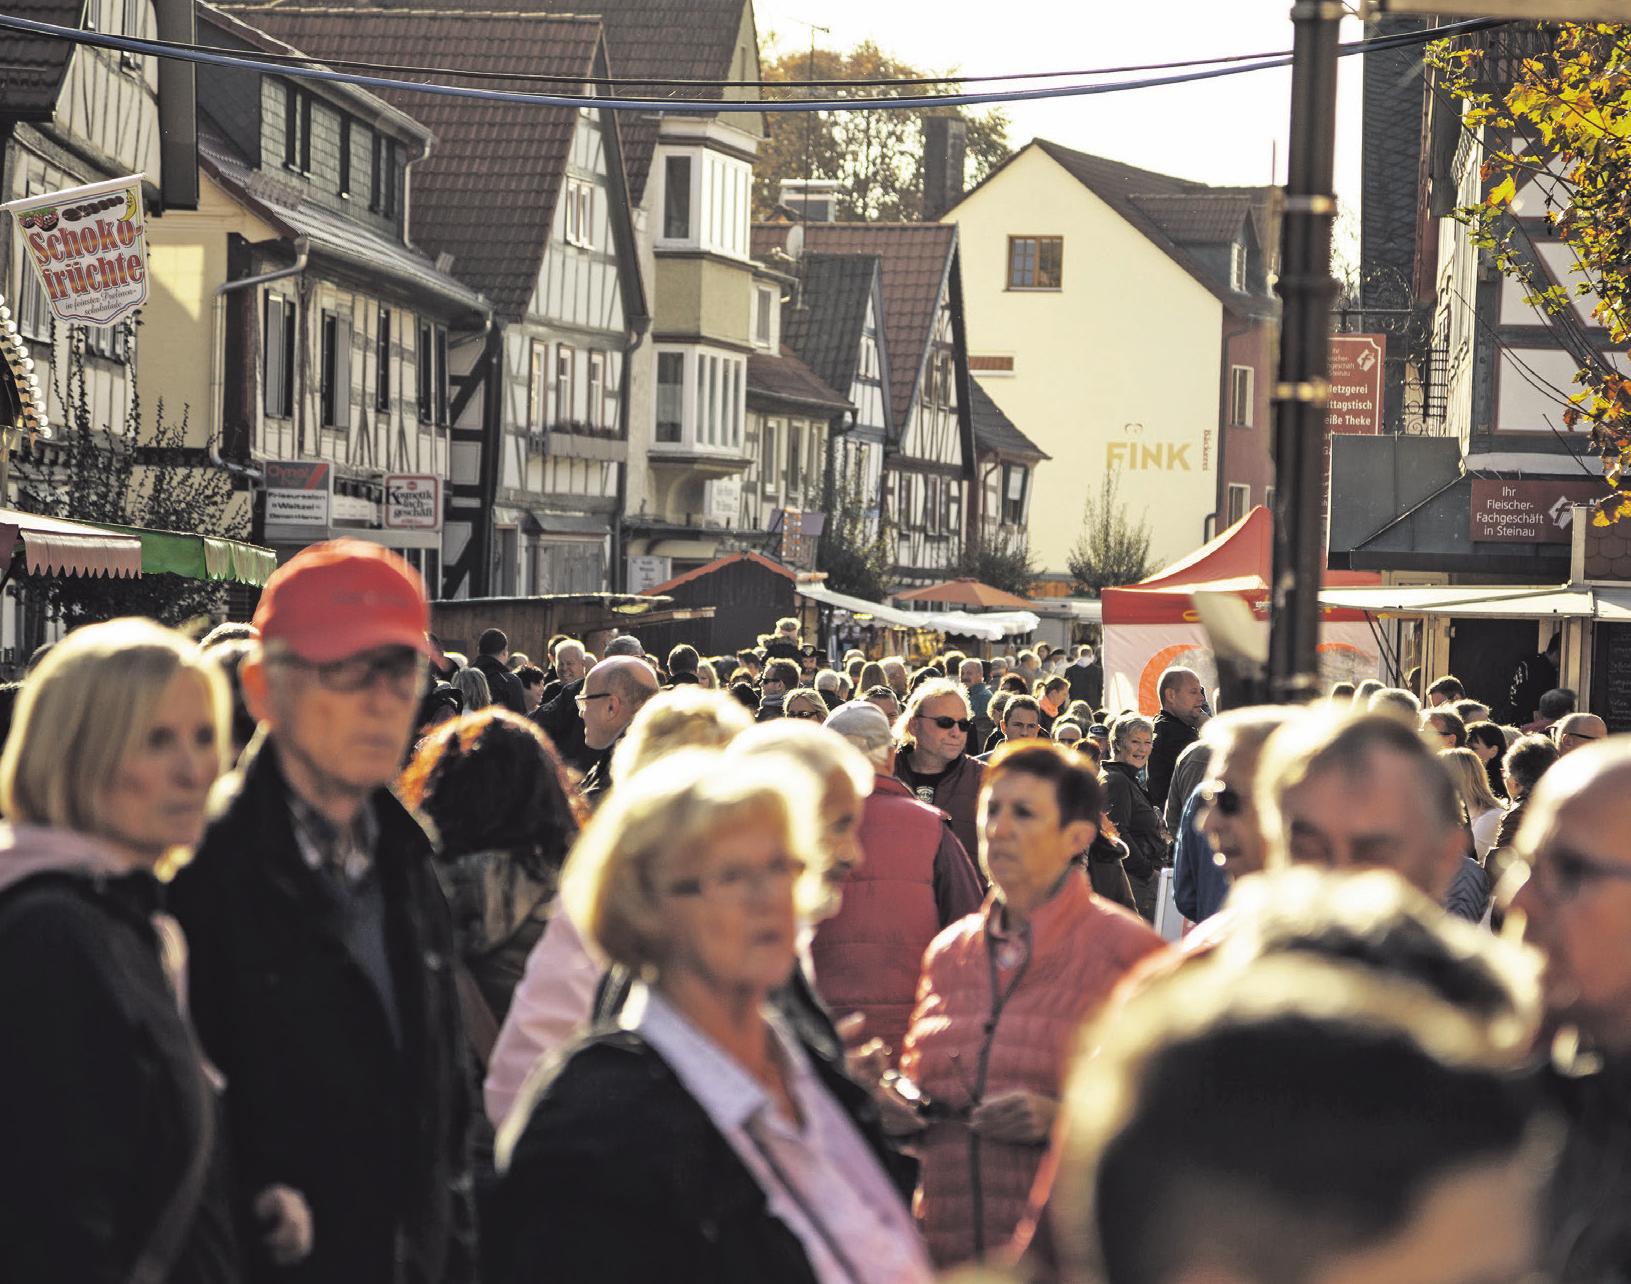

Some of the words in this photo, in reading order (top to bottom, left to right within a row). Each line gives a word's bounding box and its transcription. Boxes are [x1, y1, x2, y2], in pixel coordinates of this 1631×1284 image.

[28, 219, 143, 266] Schoko-
[42, 252, 144, 302] früchte
[1325, 415, 1343, 425] eiße
[1345, 415, 1371, 425] Theke
[1106, 441, 1191, 471] FINK
[386, 486, 432, 505] Kosmetik
[1502, 486, 1516, 497] Ihr
[1487, 499, 1534, 510] Fleischer-
[1476, 512, 1544, 525] Fachgeschäft
[1484, 526, 1493, 536] in
[1497, 526, 1535, 537] Steinau
